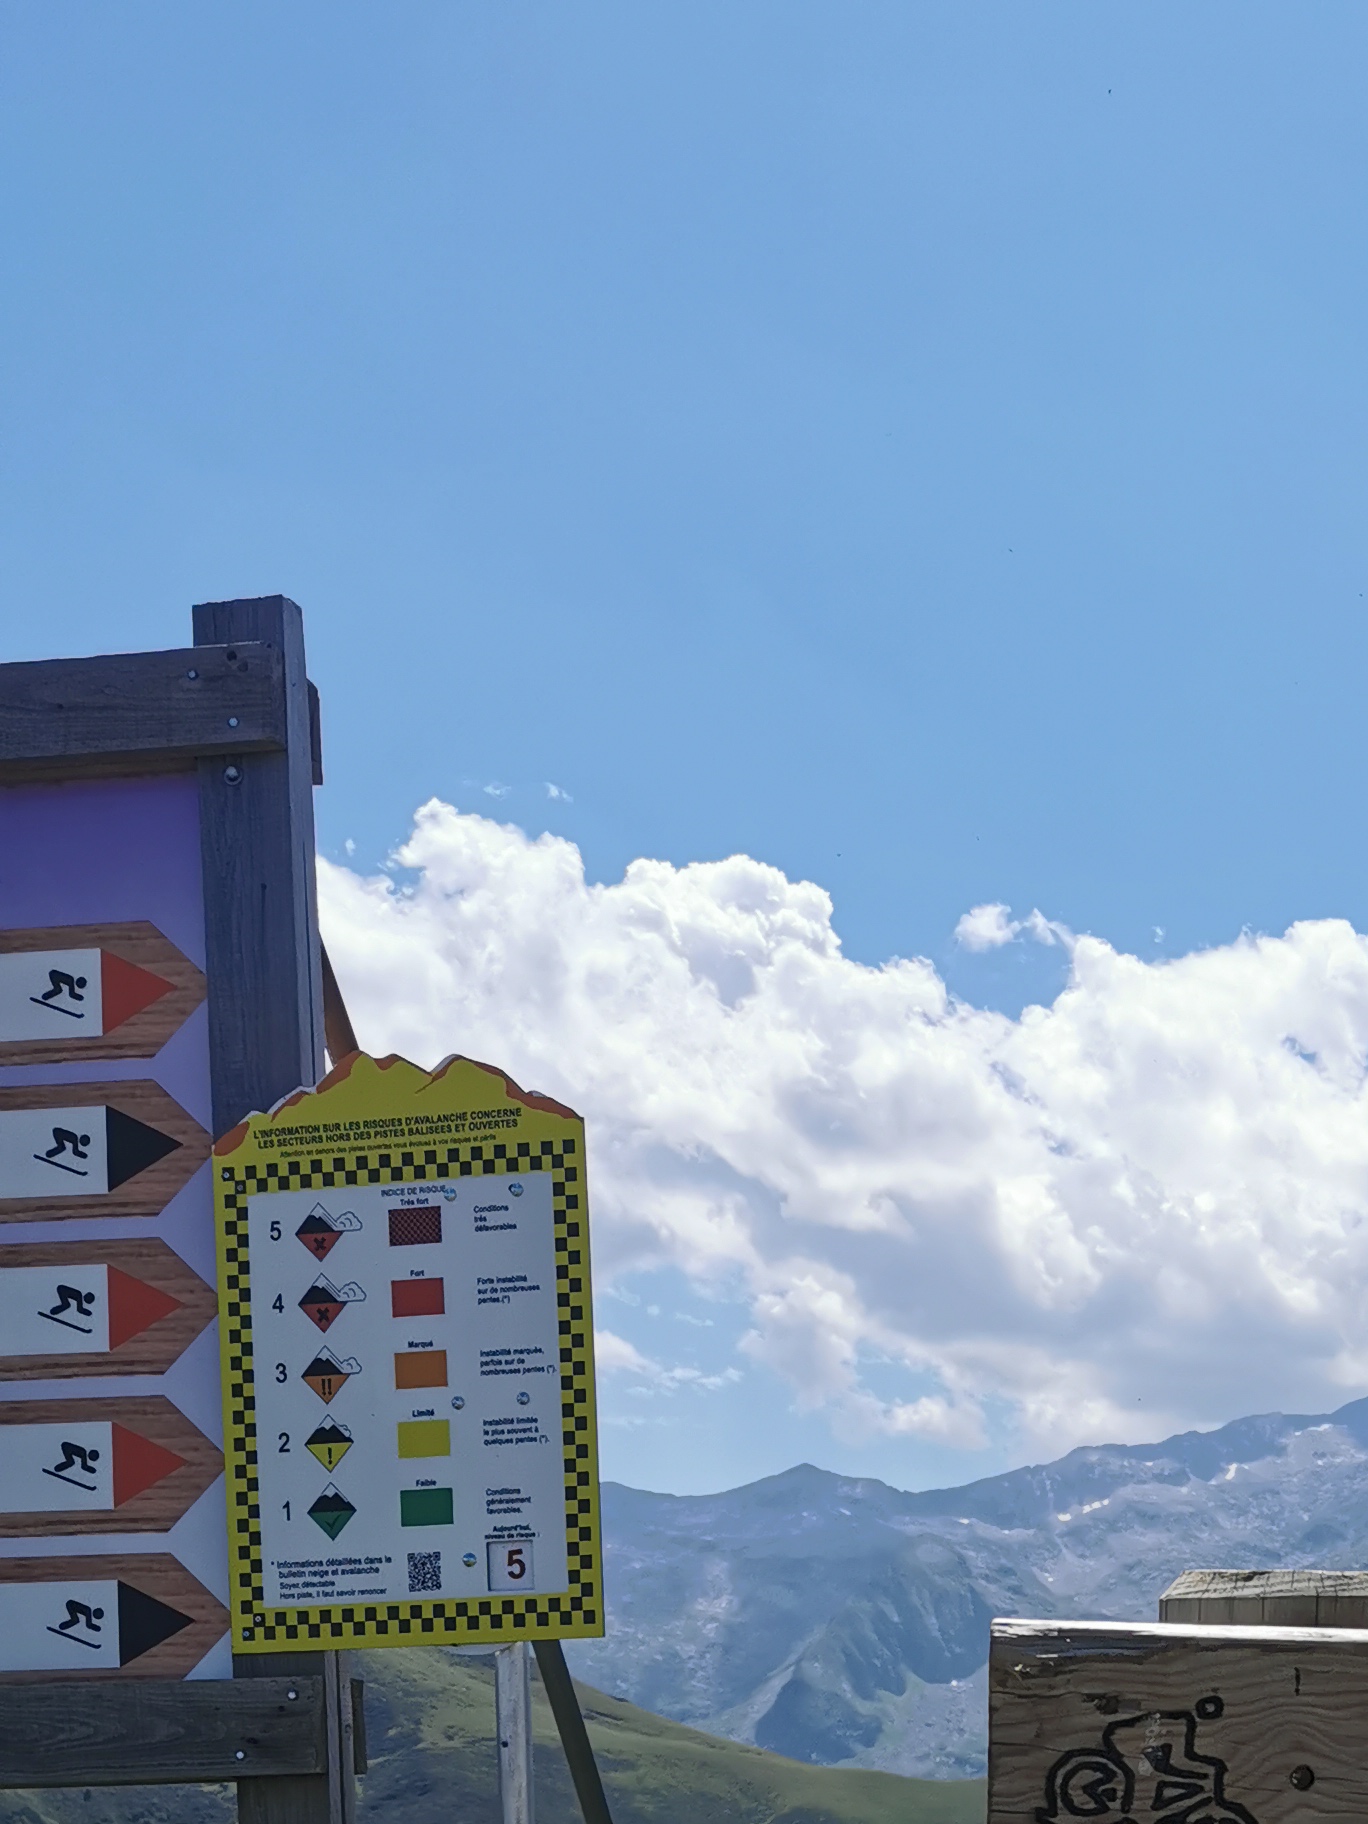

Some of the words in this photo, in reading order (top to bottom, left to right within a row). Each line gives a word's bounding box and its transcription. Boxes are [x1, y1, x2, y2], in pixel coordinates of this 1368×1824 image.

[254, 1125, 320, 1139] L'INFORMATION
[323, 1122, 341, 1133] SUR
[344, 1121, 361, 1131] LES
[363, 1118, 402, 1130] RISQUES
[405, 1112, 468, 1126] D'AVALANCHE
[470, 1108, 522, 1120] CONCERNE
[258, 1139, 275, 1149] LES
[277, 1135, 323, 1148] SECTEURS
[326, 1132, 351, 1143] HORS
[353, 1130, 371, 1141] DES
[374, 1128, 405, 1139] PISTES
[455, 1123, 466, 1133] ET
[469, 1119, 518, 1131] OUVERTES
[381, 1188, 405, 1197] INDICE
[407, 1187, 417, 1195] DE
[419, 1185, 446, 1194] RISQUE
[473, 1205, 509, 1213] Conditions
[270, 1221, 282, 1241] 5
[475, 1223, 517, 1232] défavorables
[477, 1277, 494, 1285] Forte
[496, 1274, 527, 1284] instabilité
[490, 1286, 498, 1294] de
[500, 1285, 540, 1293] nombreuses
[272, 1293, 285, 1314] 4
[408, 1340, 433, 1349] Marqué
[480, 1348, 511, 1357] Instabilité
[480, 1359, 502, 1368] parfois
[275, 1363, 288, 1383] 3
[480, 1368, 521, 1376] nombreuses
[522, 1367, 545, 1375] pentes
[412, 1409, 435, 1418] Limité
[483, 1418, 514, 1426] Instabilité
[491, 1428, 505, 1436] plus
[507, 1426, 533, 1434] souvent
[278, 1432, 291, 1453] 2
[484, 1438, 514, 1446] quelques
[515, 1436, 538, 1445] pentes
[416, 1479, 437, 1487] Faible
[486, 1488, 521, 1496] Conditions
[485, 1496, 531, 1507] généralement
[282, 1501, 291, 1521] 1
[277, 1560, 324, 1569] Informations
[325, 1558, 361, 1566] détaillées
[364, 1556, 383, 1564] dans
[384, 1555, 392, 1563] le
[507, 1549, 526, 1579] 5
[279, 1570, 306, 1579] bulletin
[308, 1569, 329, 1578] neige
[331, 1568, 339, 1576] et
[341, 1566, 380, 1576] avalanche
[301, 1580, 335, 1589] détectable
[336, 1588, 356, 1596] savoir
